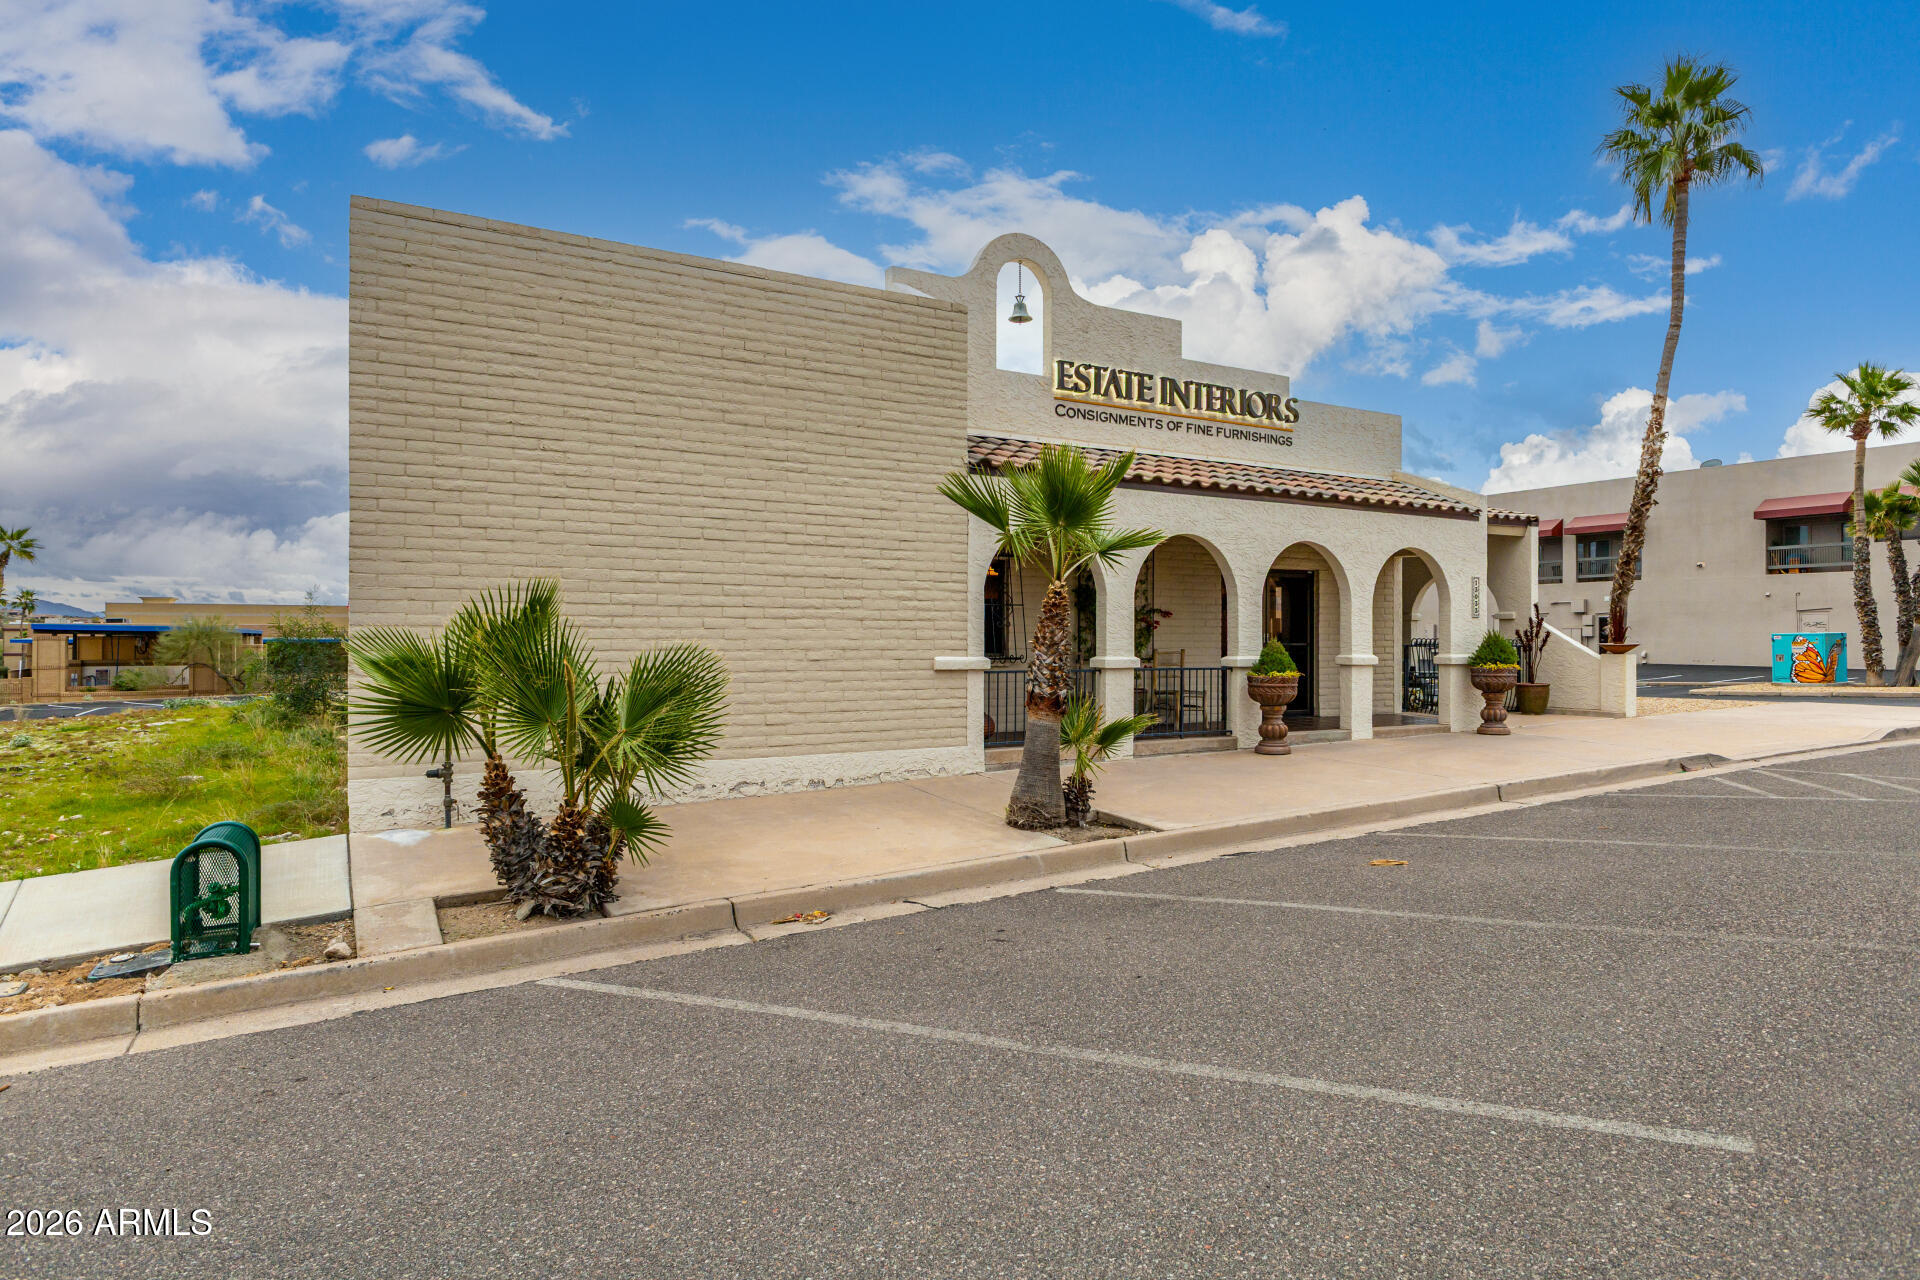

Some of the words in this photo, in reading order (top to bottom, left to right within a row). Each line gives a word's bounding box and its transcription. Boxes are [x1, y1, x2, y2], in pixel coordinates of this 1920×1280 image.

[1056, 360, 1155, 403] ESTATE
[1159, 377, 1300, 423] INTERIORS
[1055, 404, 1163, 430] CONSIGNMENTS
[1167, 421, 1183, 432] OF
[1186, 423, 1214, 436] FINE
[1216, 427, 1293, 446] FURNISHINGS
